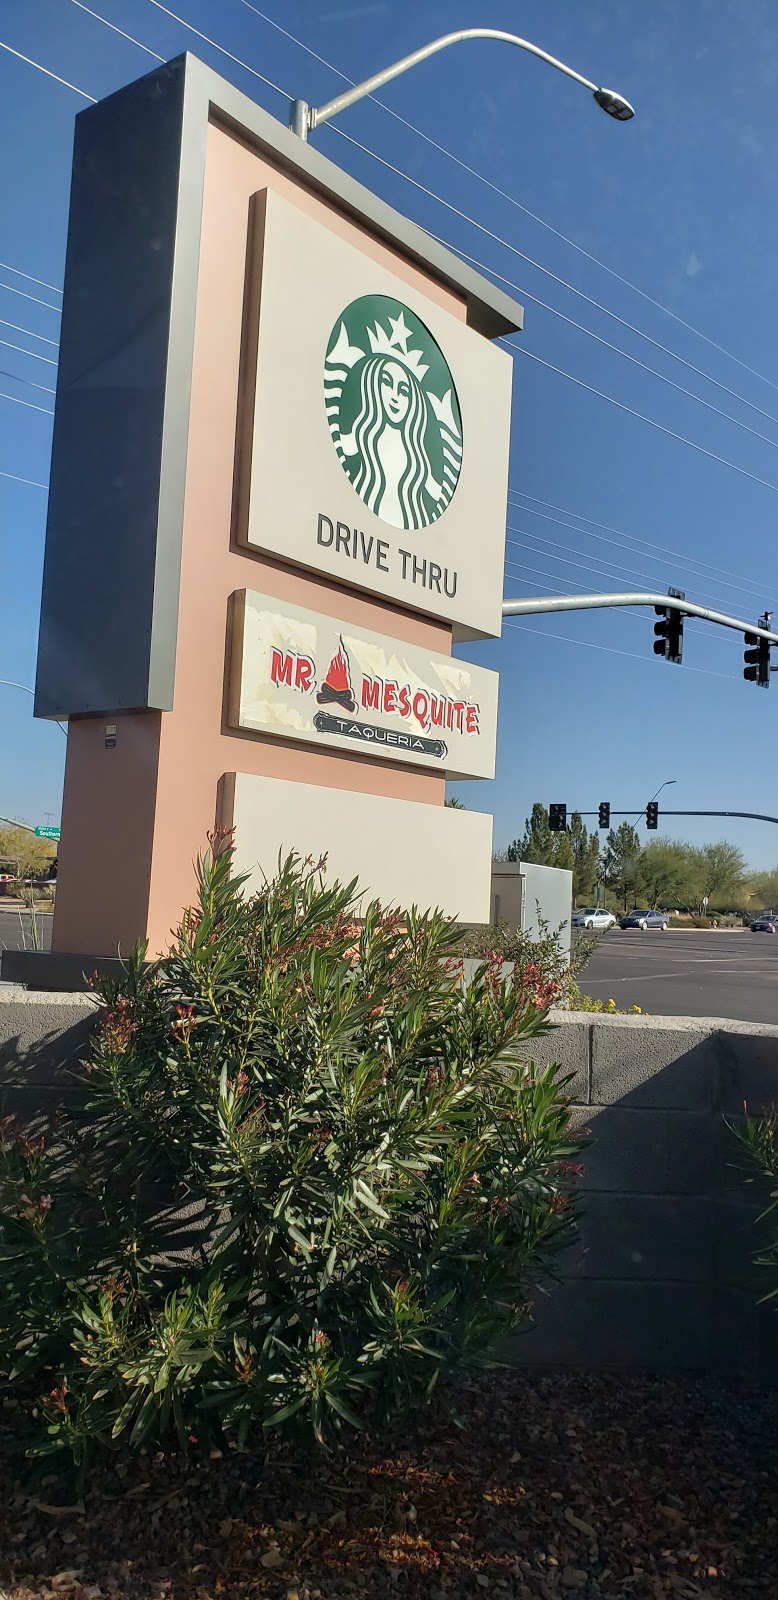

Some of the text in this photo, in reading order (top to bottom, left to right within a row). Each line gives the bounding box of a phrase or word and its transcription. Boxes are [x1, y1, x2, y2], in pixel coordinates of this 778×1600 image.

[317, 513, 457, 598] DRIVE THRU
[270, 646, 480, 735] MR MESQUITE
[336, 720, 425, 750] TAQUERIA
